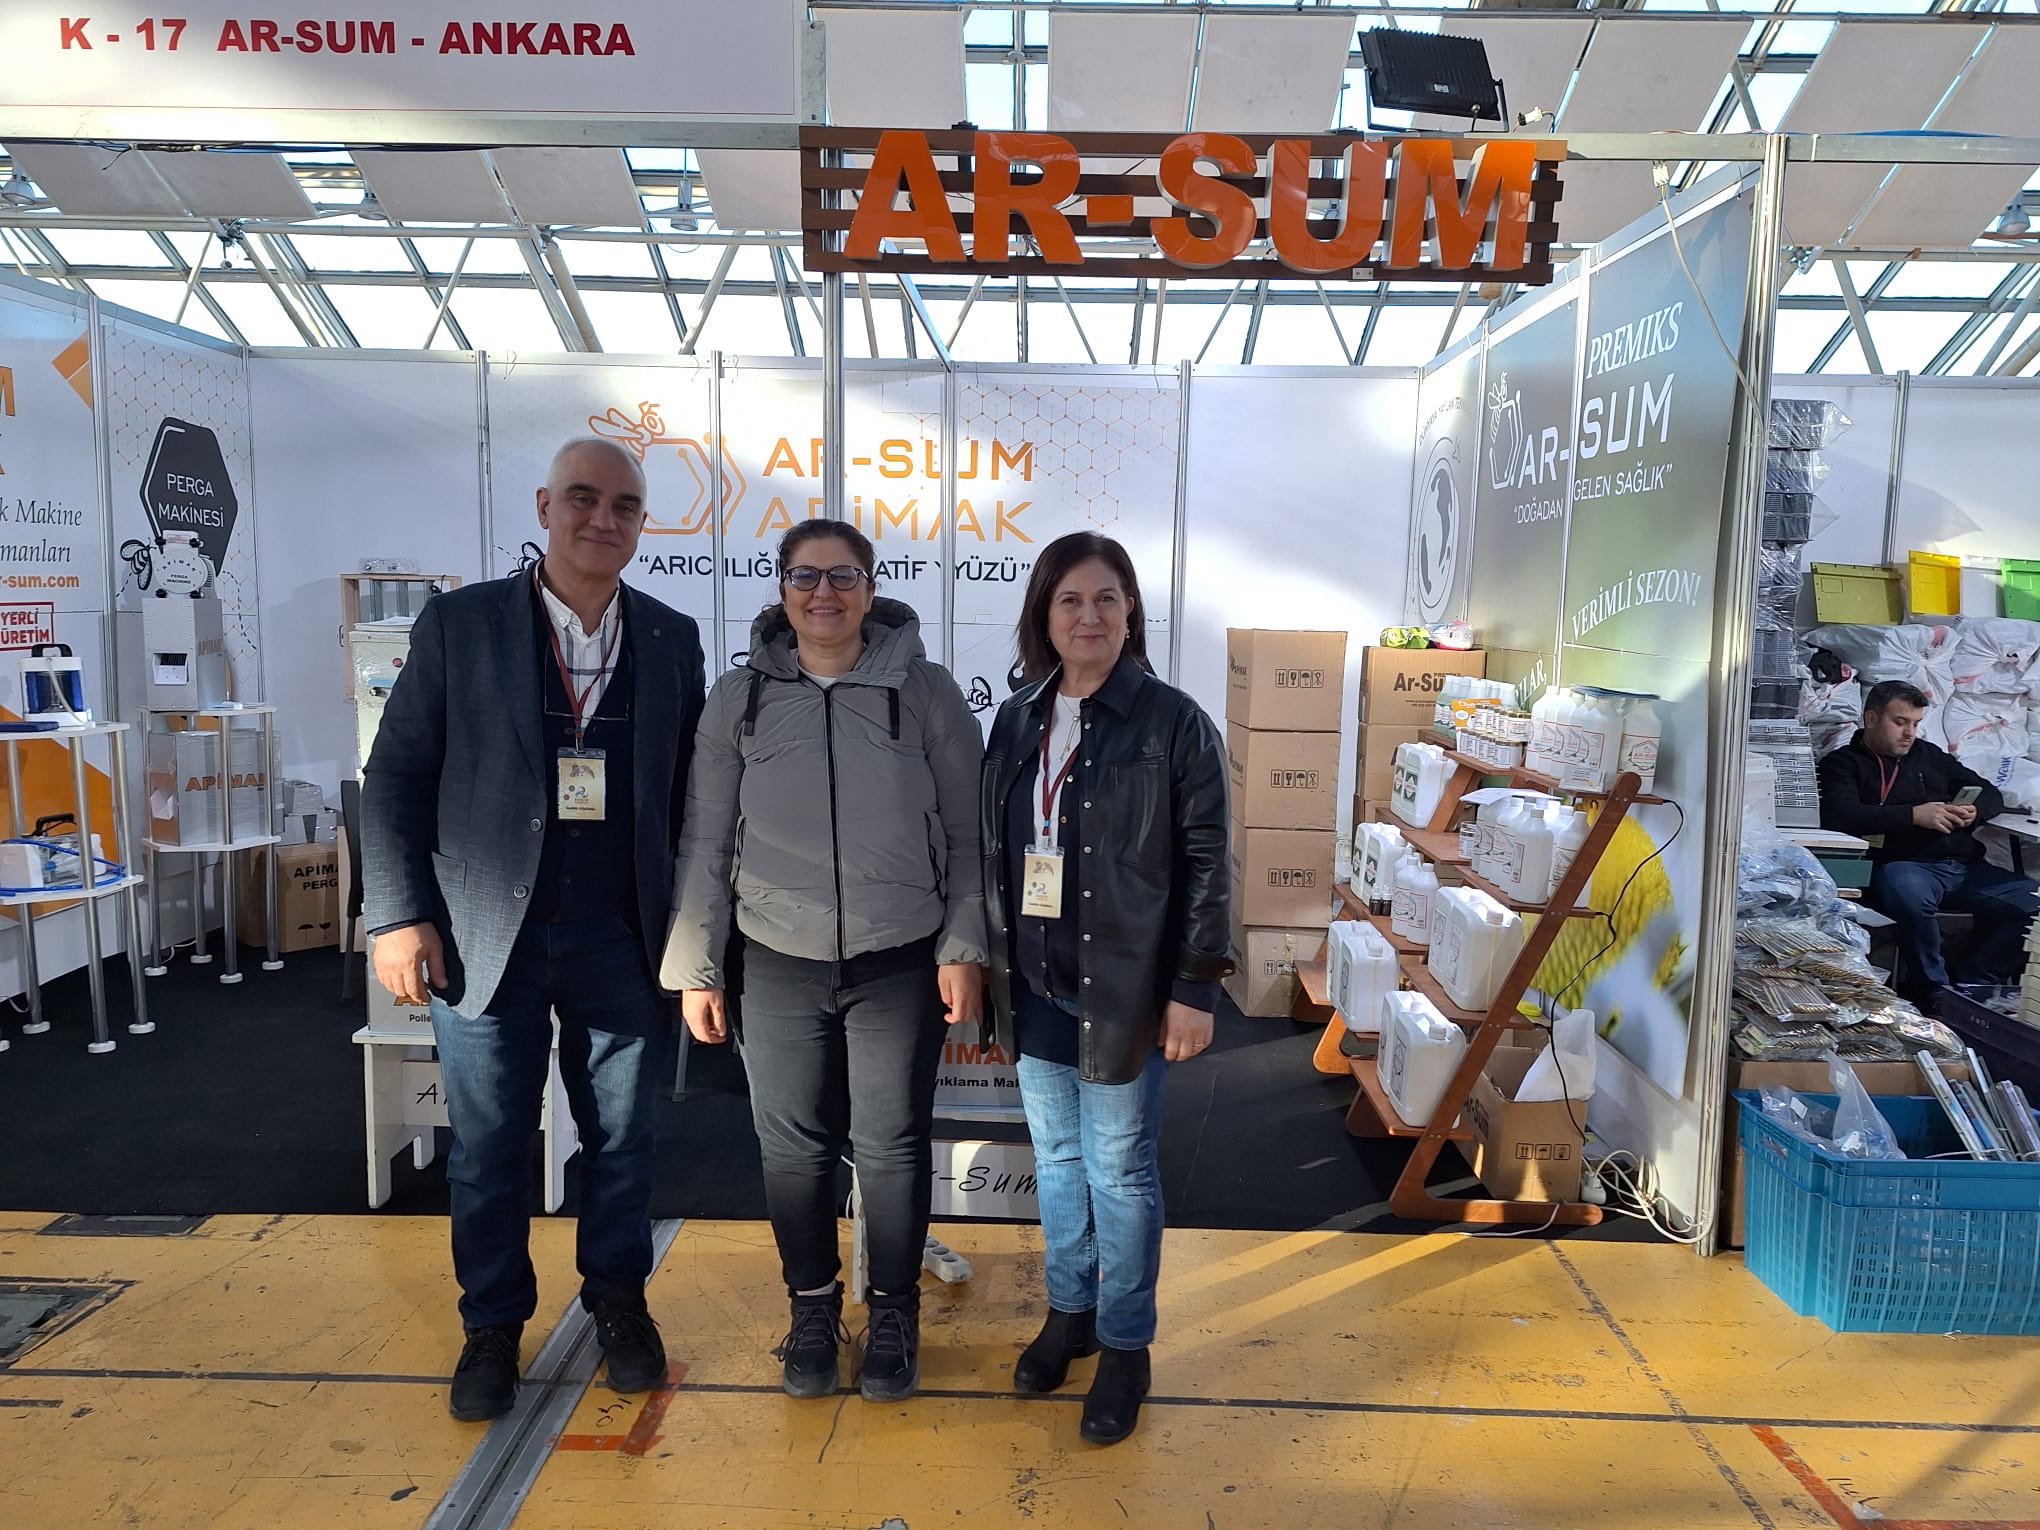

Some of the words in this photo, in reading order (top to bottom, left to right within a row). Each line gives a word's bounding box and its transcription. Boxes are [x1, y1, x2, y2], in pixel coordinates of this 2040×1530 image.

[61, 18, 92, 49] K
[136, 19, 188, 50] 17
[217, 20, 397, 54] AR-SUM
[439, 22, 636, 56] ANKARA
[842, 130, 1536, 272] AR-SUM
[1586, 302, 1683, 379] PREMIKS
[1518, 373, 1675, 489] AR-SUM
[167, 473, 215, 498] PERGA
[1573, 474, 1612, 501] GELEN
[1615, 460, 1673, 496] SAĞLIK”
[15, 498, 82, 526] Makine
[158, 501, 224, 527] MAKİNESİ
[0, 608, 39, 627] YERLİ
[1572, 569, 1633, 641] VERİMLİ
[1635, 569, 1701, 608] SEZON!
[0, 627, 50, 645] ÜRETİM
[1514, 656, 1547, 706] ILAR,
[294, 862, 339, 878] APİM
[944, 1037, 1015, 1066] İMA
[931, 1166, 1037, 1195] -Sum
